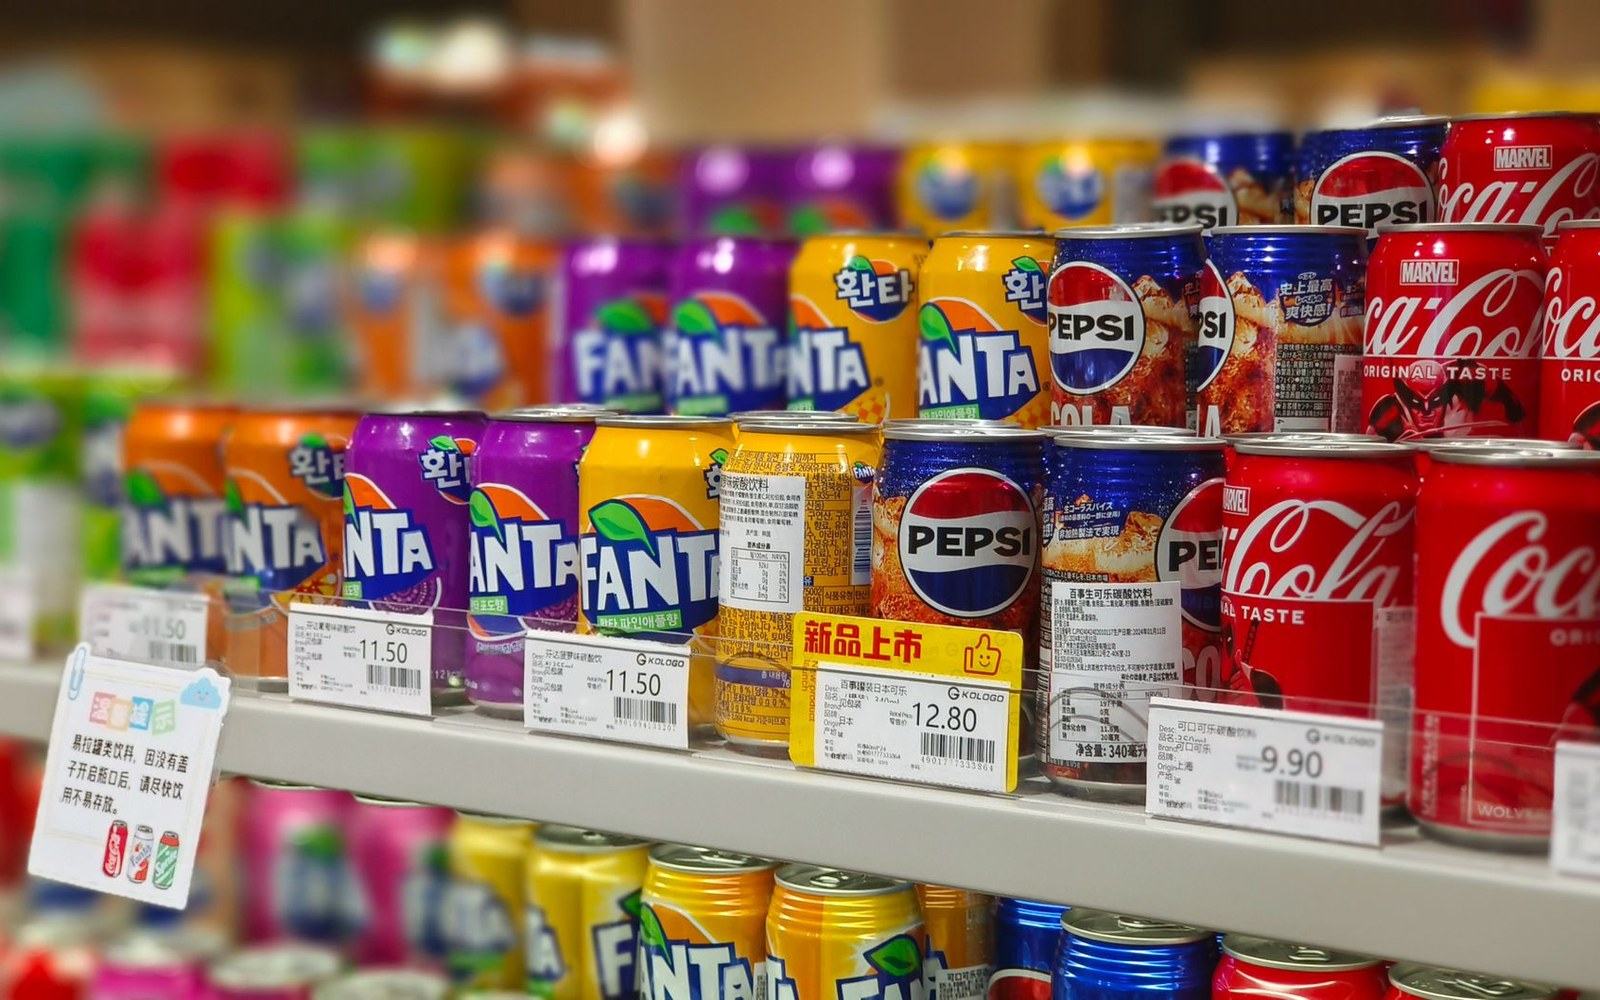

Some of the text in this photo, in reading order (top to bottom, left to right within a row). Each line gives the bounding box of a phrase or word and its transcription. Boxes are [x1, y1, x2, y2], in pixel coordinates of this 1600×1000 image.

[1496, 148, 1549, 168] MARVEL
[1318, 200, 1427, 228] PEPSI
[1402, 262, 1457, 283] MARVEL
[835, 268, 912, 309] 환타
[1200, 311, 1226, 339] SI
[1364, 365, 1512, 380] ORIGINAL TASTE
[420, 447, 470, 490] 환
[343, 510, 434, 579] NTA
[908, 526, 1031, 556] PEPSI
[1222, 499, 1415, 608] -Cola
[1169, 540, 1222, 572] PE
[1069, 588, 1153, 600] 百事生可乐碳酸饮料
[1241, 606, 1305, 625] TASTE
[360, 639, 408, 664] 11.50
[804, 621, 923, 664] 新品上市
[648, 659, 685, 668] KOLOGO
[606, 669, 661, 696] 11.50
[961, 690, 1005, 703] KOLOGO
[912, 702, 978, 733] 12.80
[1261, 745, 1324, 778] 9.90
